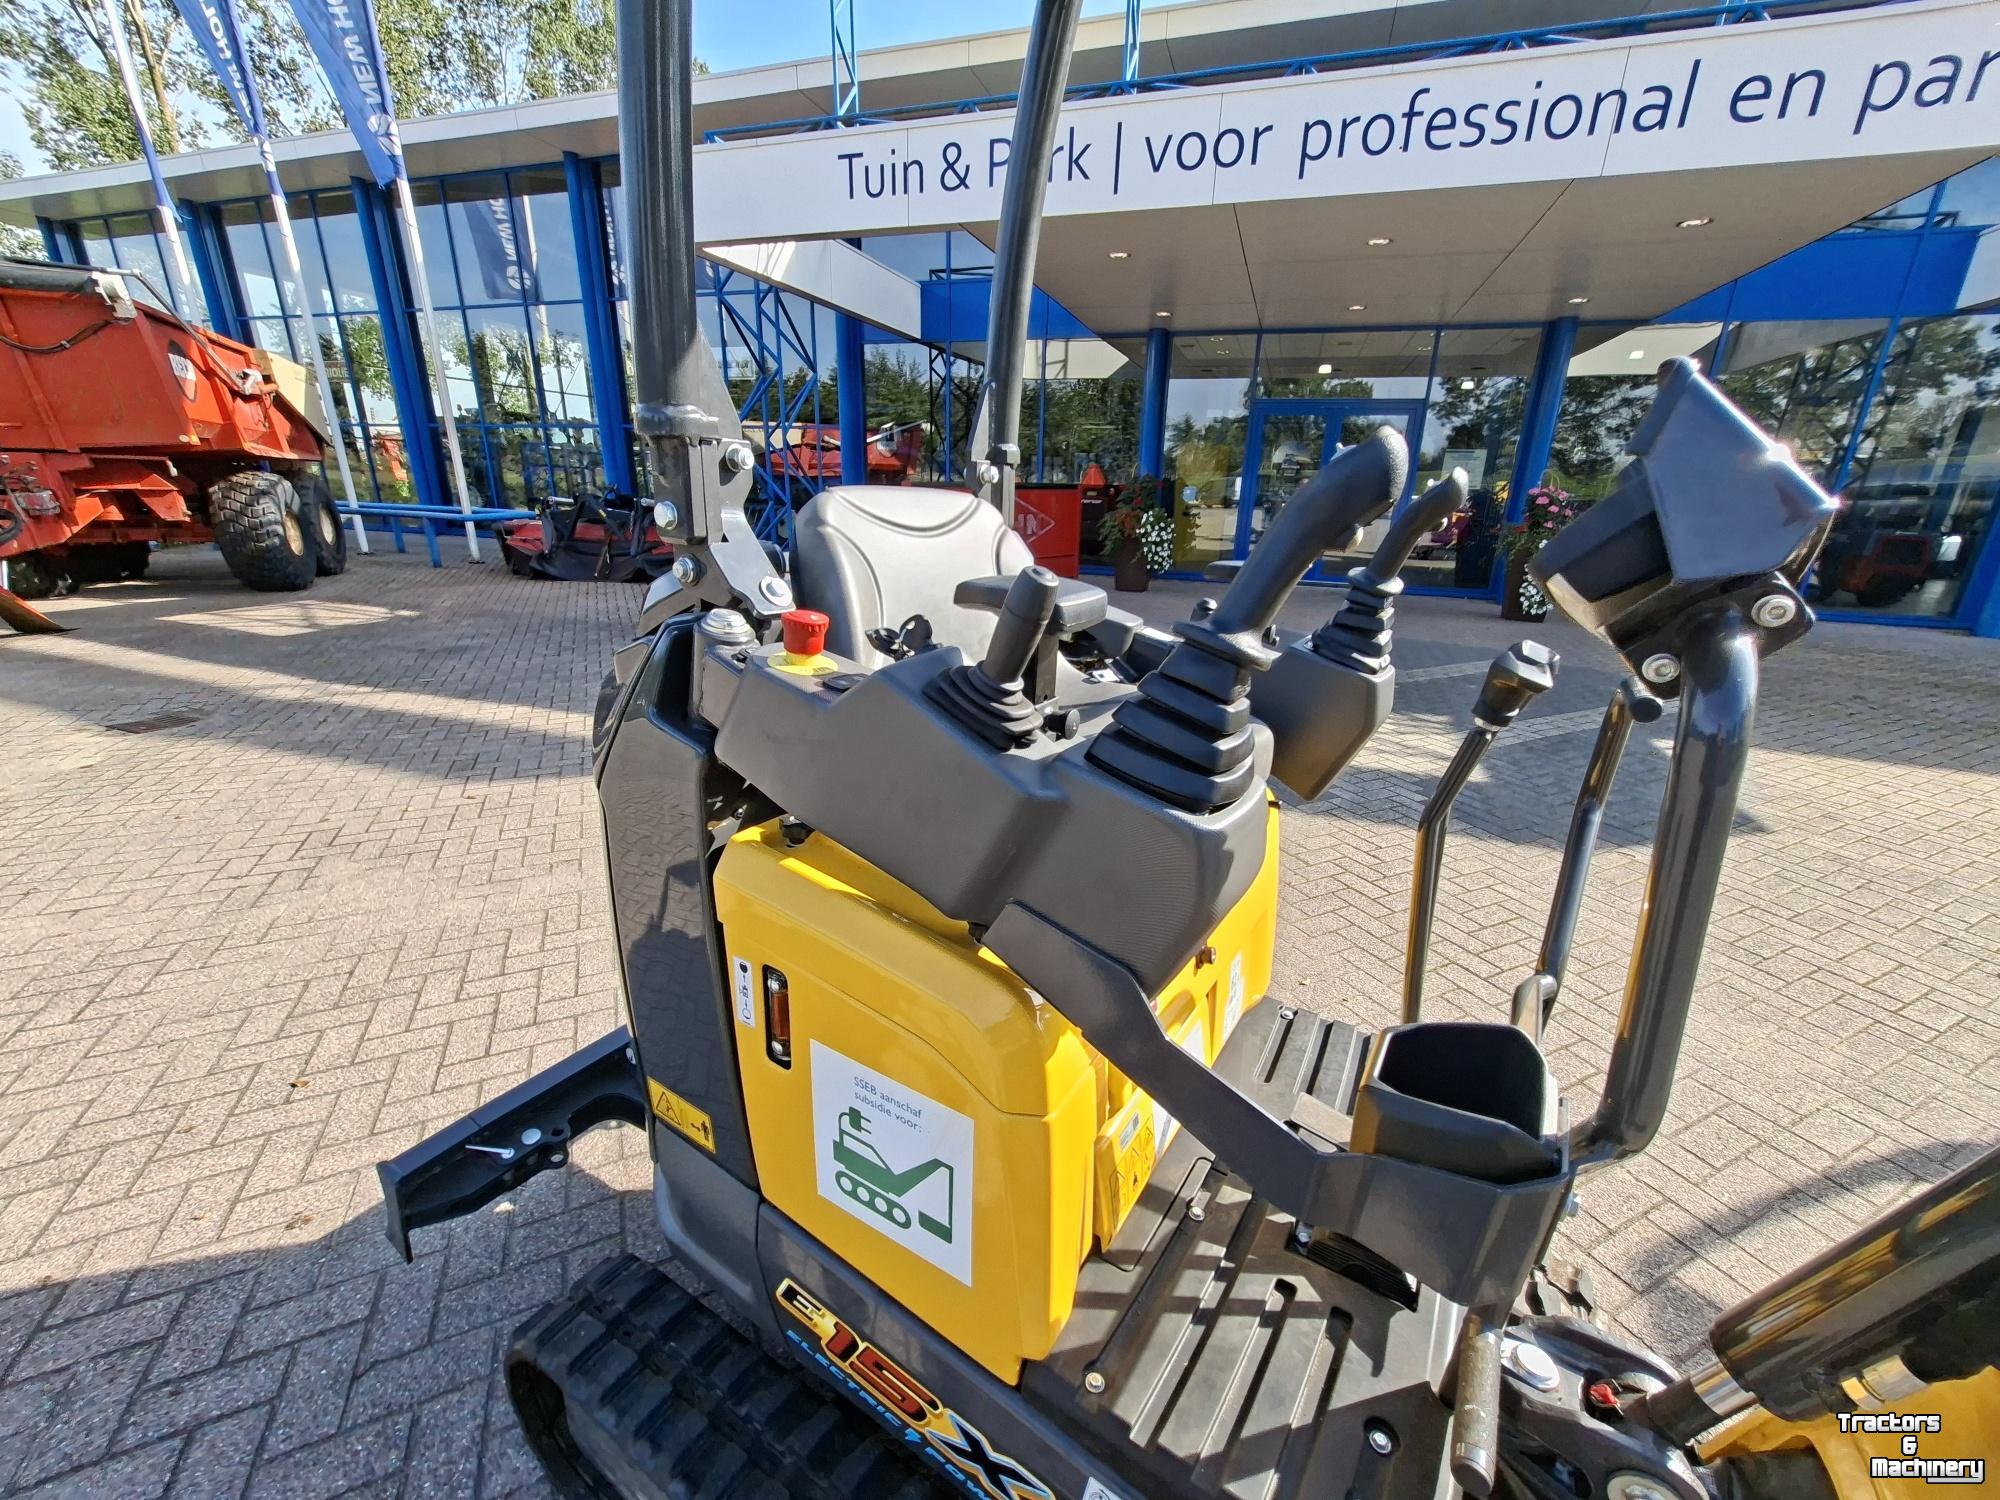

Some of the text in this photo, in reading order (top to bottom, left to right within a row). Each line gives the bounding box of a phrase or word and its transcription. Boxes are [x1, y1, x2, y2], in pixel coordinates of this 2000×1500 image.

[837, 148, 924, 200] Tuin
[940, 142, 970, 192] &
[988, 126, 1092, 188] Prk
[1145, 124, 1274, 172] voor
[1298, 58, 1702, 180] professional
[1729, 69, 1826, 123] en
[853, 1076, 923, 1119] SSEB aanschaf
[854, 1092, 892, 1117] subsidie
[786, 1329, 902, 1427] ELECTRIC
